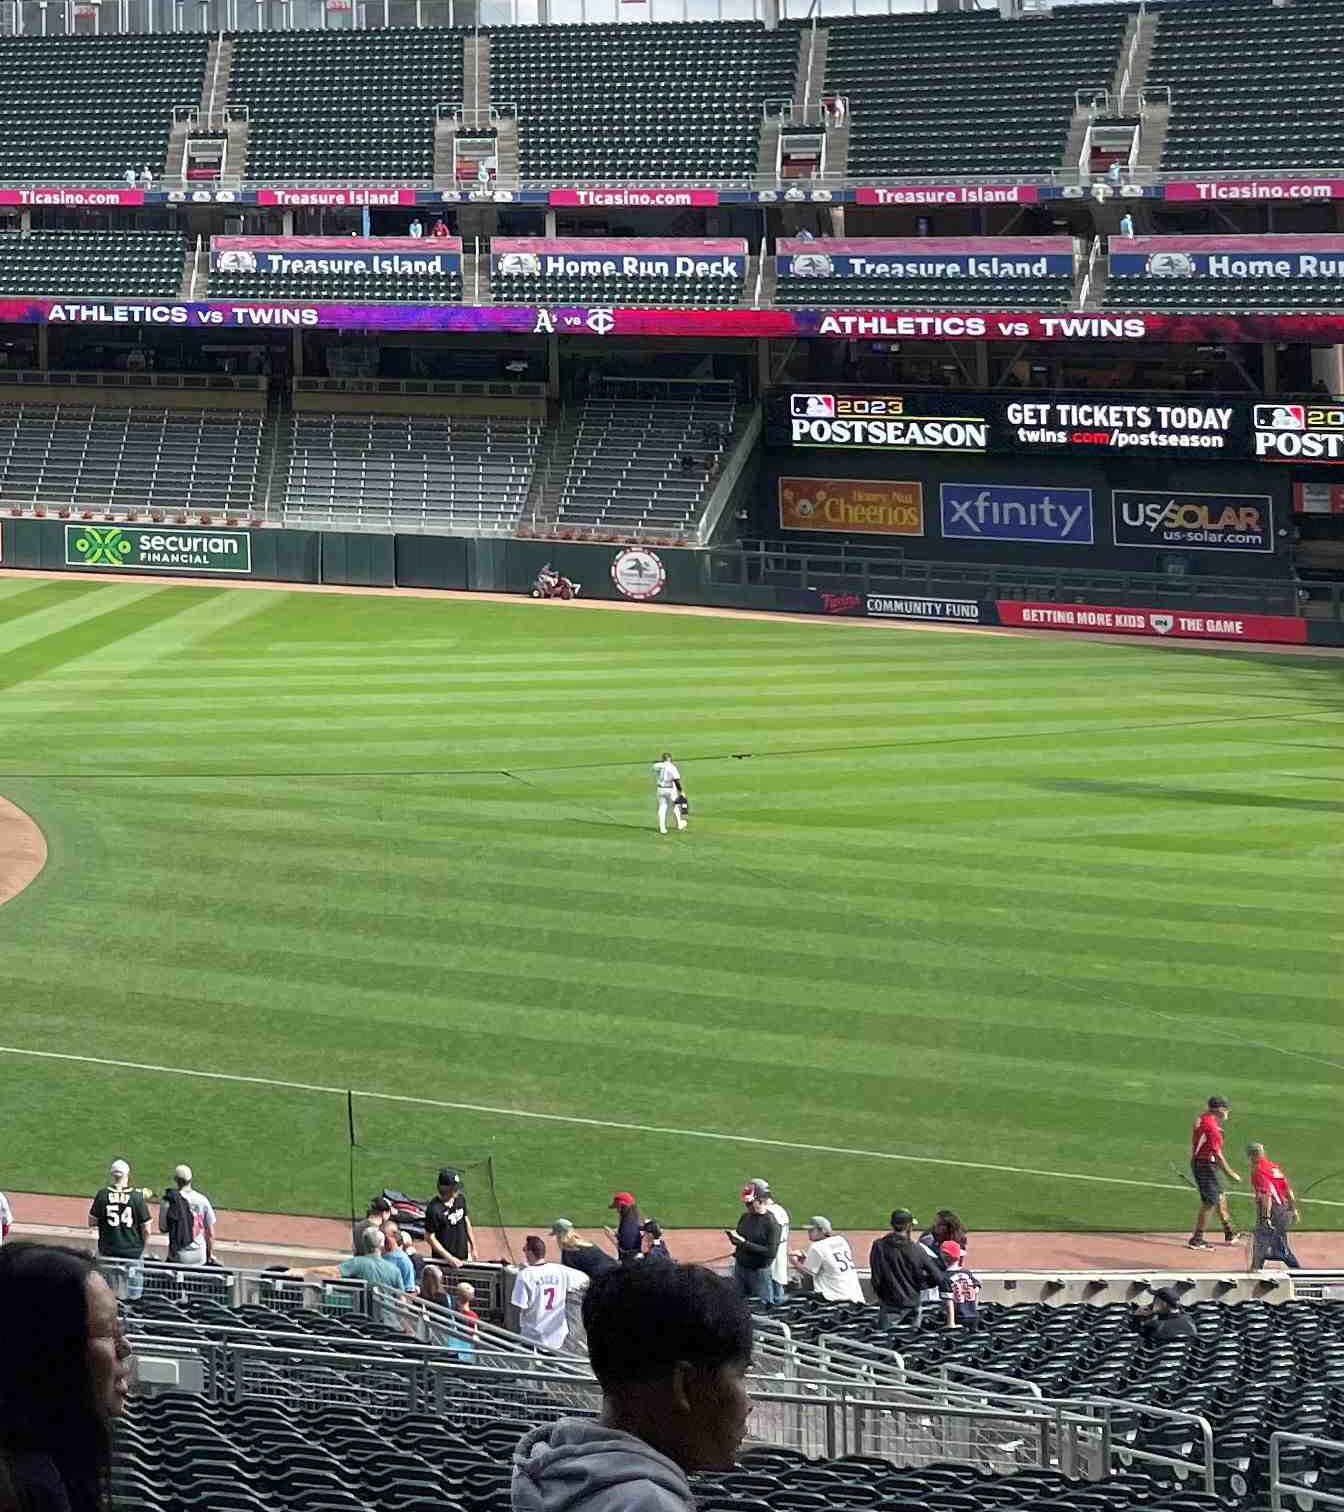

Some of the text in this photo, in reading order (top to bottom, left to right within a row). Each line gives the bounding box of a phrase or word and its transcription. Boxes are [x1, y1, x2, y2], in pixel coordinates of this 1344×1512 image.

[19, 190, 120, 205] TIcasino.com
[273, 190, 400, 205] Treasure Island
[576, 190, 692, 205] TIcasino.com
[874, 187, 1018, 203] Treasure Island
[1196, 182, 1332, 199] TIcasino.com
[267, 253, 443, 274] Treasure Island
[546, 256, 737, 277] Home Run Deck
[848, 256, 1048, 277] Treasure Island
[1207, 255, 1291, 277] Home
[48, 304, 319, 325] ATHLETICS vs TWINS
[563, 316, 582, 326] vs
[819, 316, 1146, 337] ATHLETICS vs TWINS
[836, 399, 903, 414] 2023
[1007, 403, 1233, 430] GET TICKETS TODAY
[792, 418, 987, 448] POSTSEASON
[824, 496, 919, 526] Cheerios
[950, 492, 1083, 536] xfinity
[139, 534, 238, 554] securian
[139, 552, 210, 564] FINANCIAL
[866, 597, 943, 617] COMMUNITY
[945, 601, 979, 618] FUND
[1021, 608, 1074, 626] GETTING
[1077, 610, 1113, 627] MORE
[1115, 612, 1146, 629] KIDS
[1179, 617, 1205, 632] THE
[1206, 619, 1244, 635] GAME
[105, 1204, 135, 1228] 54
[543, 1287, 556, 1311] 7
